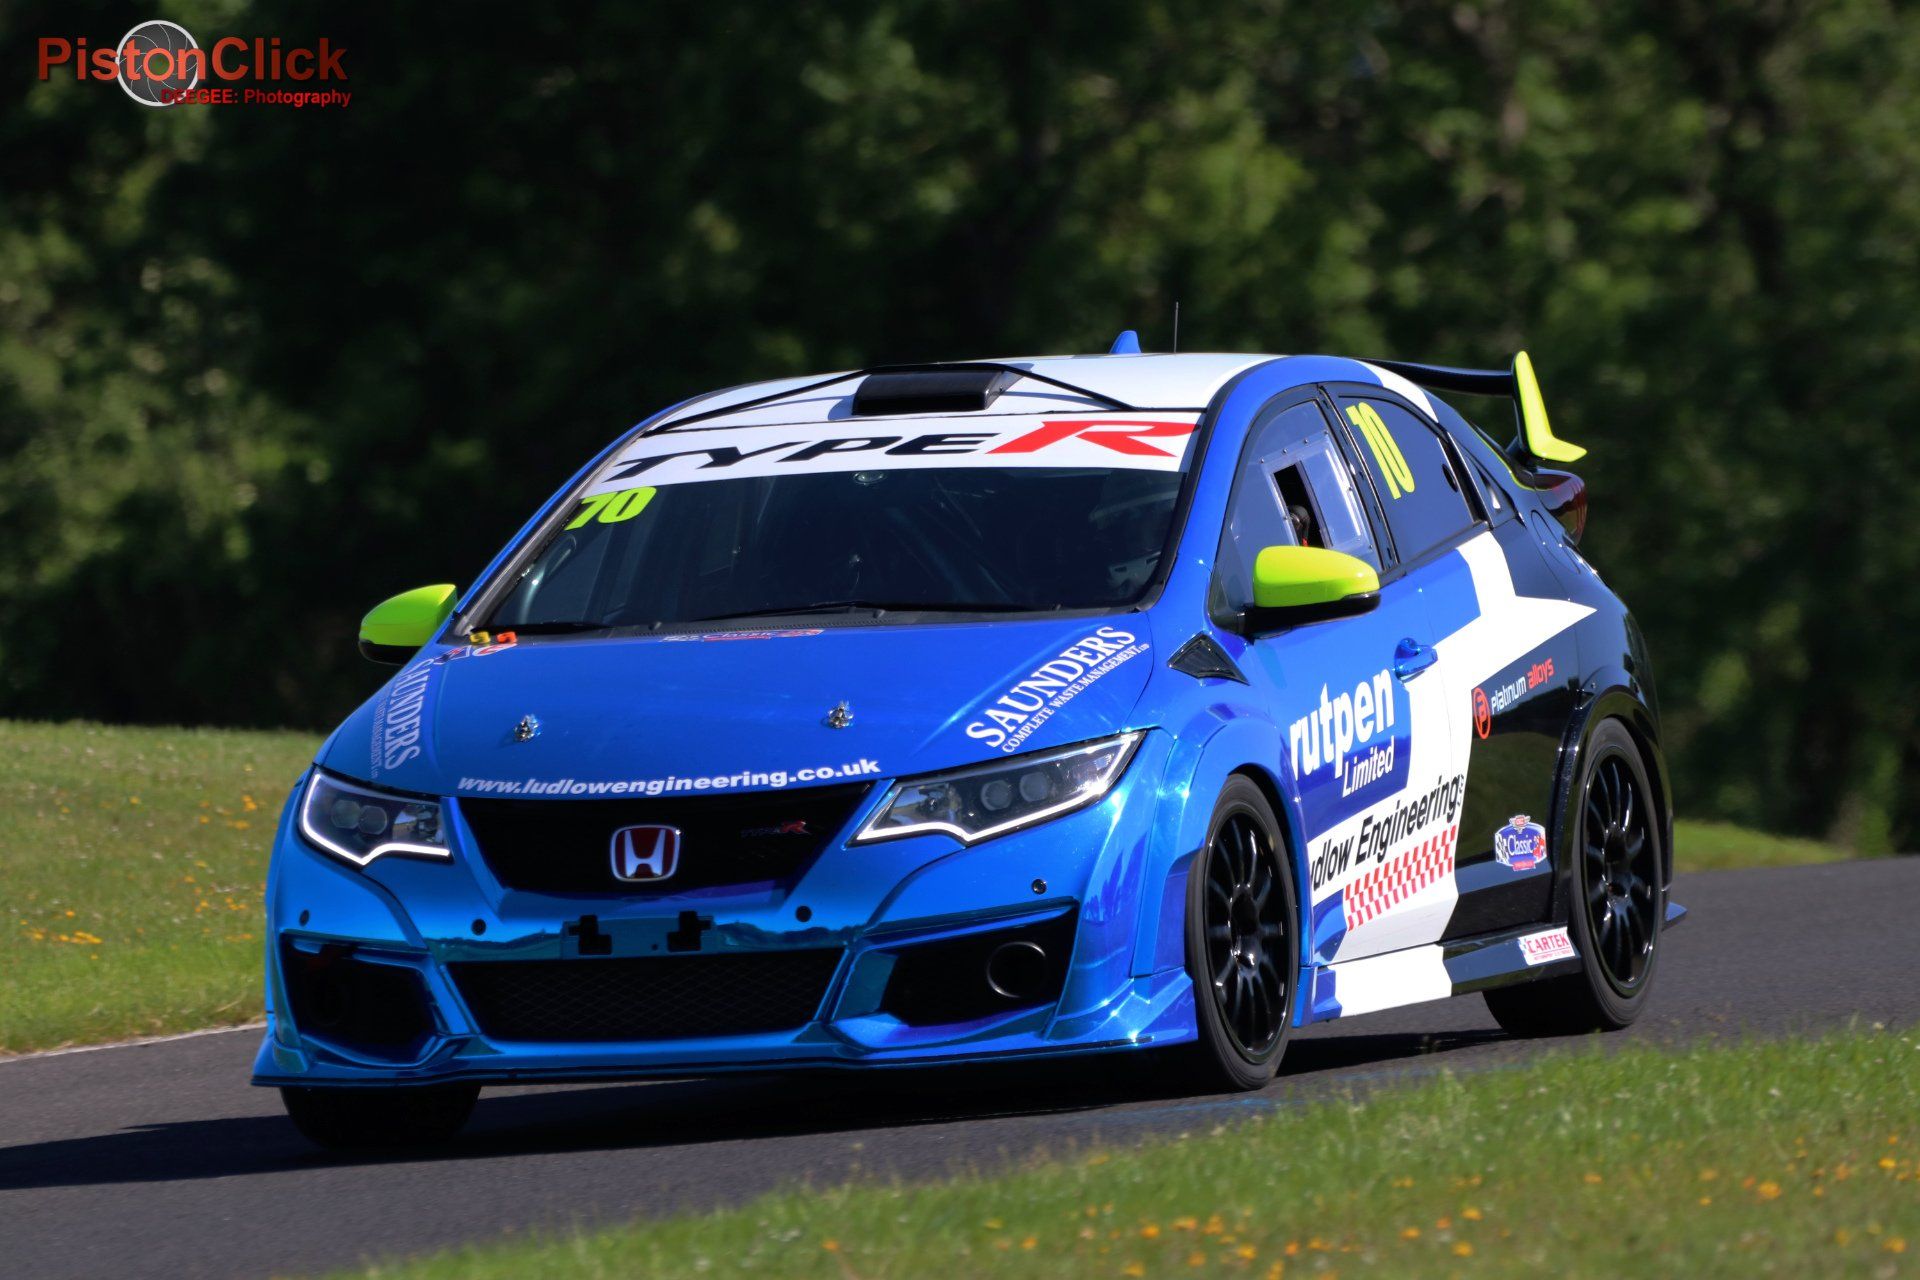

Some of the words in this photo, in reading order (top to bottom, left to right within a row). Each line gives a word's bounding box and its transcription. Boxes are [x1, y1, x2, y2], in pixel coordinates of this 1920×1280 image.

[602, 432, 1002, 483] TYPE
[985, 420, 1200, 457] R
[564, 486, 657, 531] 70
[387, 658, 434, 770] SAUNDERS
[965, 626, 1136, 748] SAUNDERS
[1002, 706, 1055, 753] COMPLETE
[1051, 681, 1085, 709] WASTE
[1081, 645, 1143, 687] MANAGEMENT
[1491, 676, 1527, 715] platinum
[1527, 657, 1554, 689] alloys
[1289, 668, 1395, 780] rutpen
[457, 759, 881, 796] www.ludlowengineering.co.uk
[1342, 735, 1394, 798] Limited
[1355, 774, 1461, 866] Engineering
[1507, 834, 1534, 856] Classic
[1526, 933, 1570, 954] CARTEK
